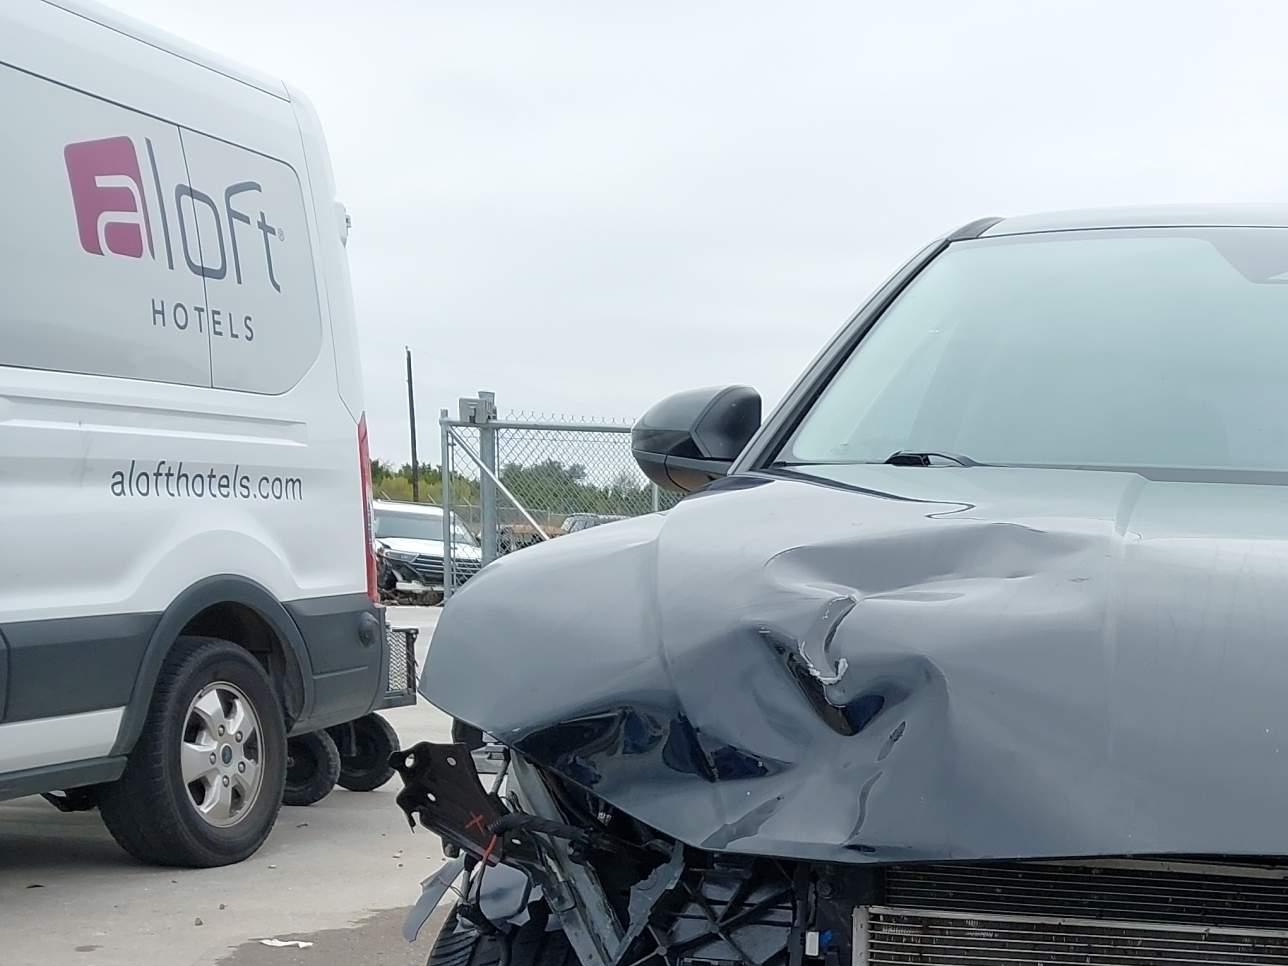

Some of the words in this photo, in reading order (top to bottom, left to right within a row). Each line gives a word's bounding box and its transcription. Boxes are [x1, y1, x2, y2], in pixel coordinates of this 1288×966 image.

[64, 135, 281, 293] aloft
[151, 298, 255, 342] HOTELS
[110, 459, 303, 501] alofthotels.com
